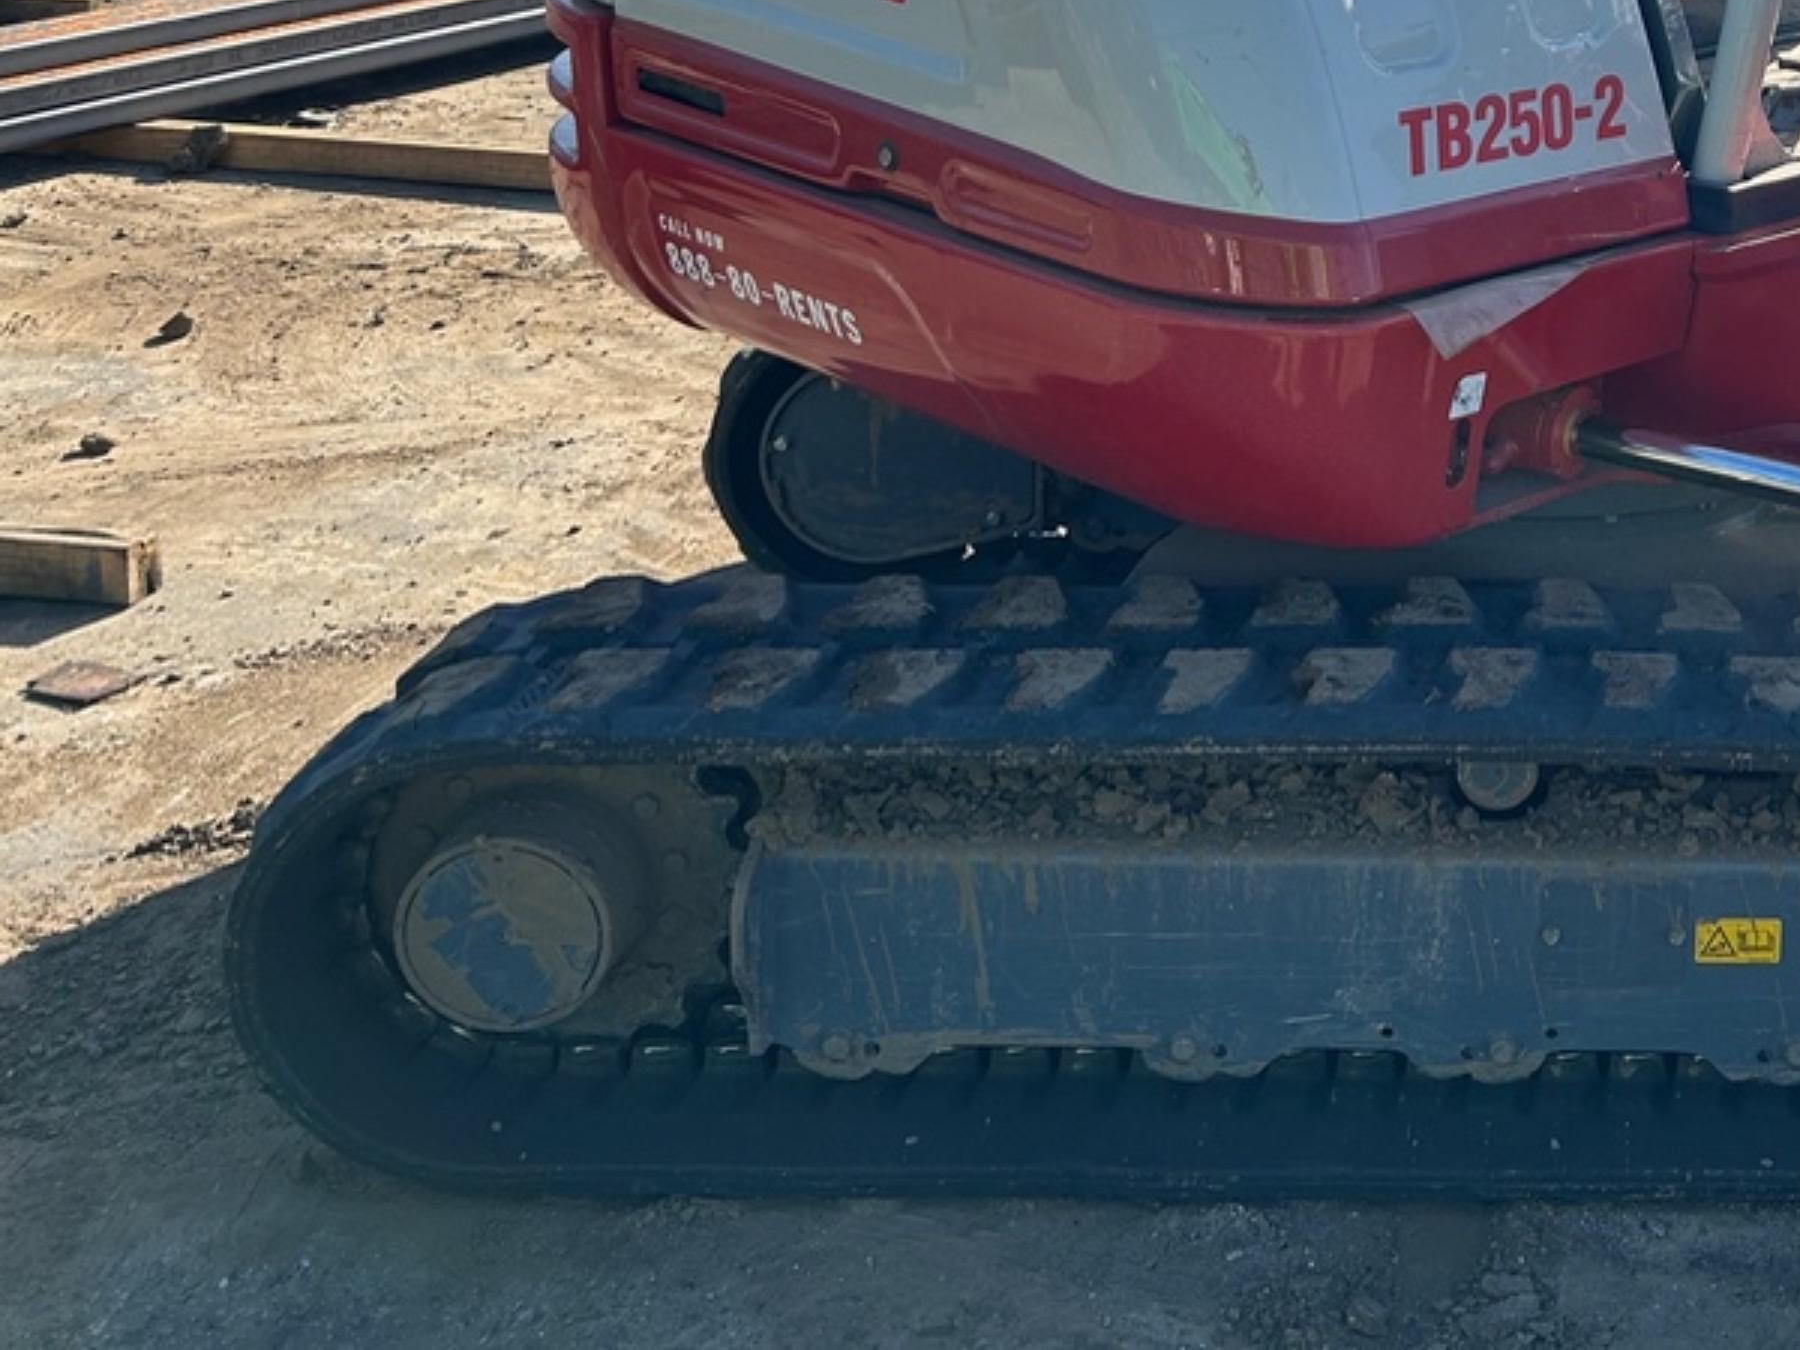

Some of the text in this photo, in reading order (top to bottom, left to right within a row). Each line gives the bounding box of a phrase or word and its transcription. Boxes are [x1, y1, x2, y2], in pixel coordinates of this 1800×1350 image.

[1397, 73, 1628, 178] TB250-2
[658, 213, 691, 241] CALL
[665, 241, 863, 346] 888-80-RENTS
